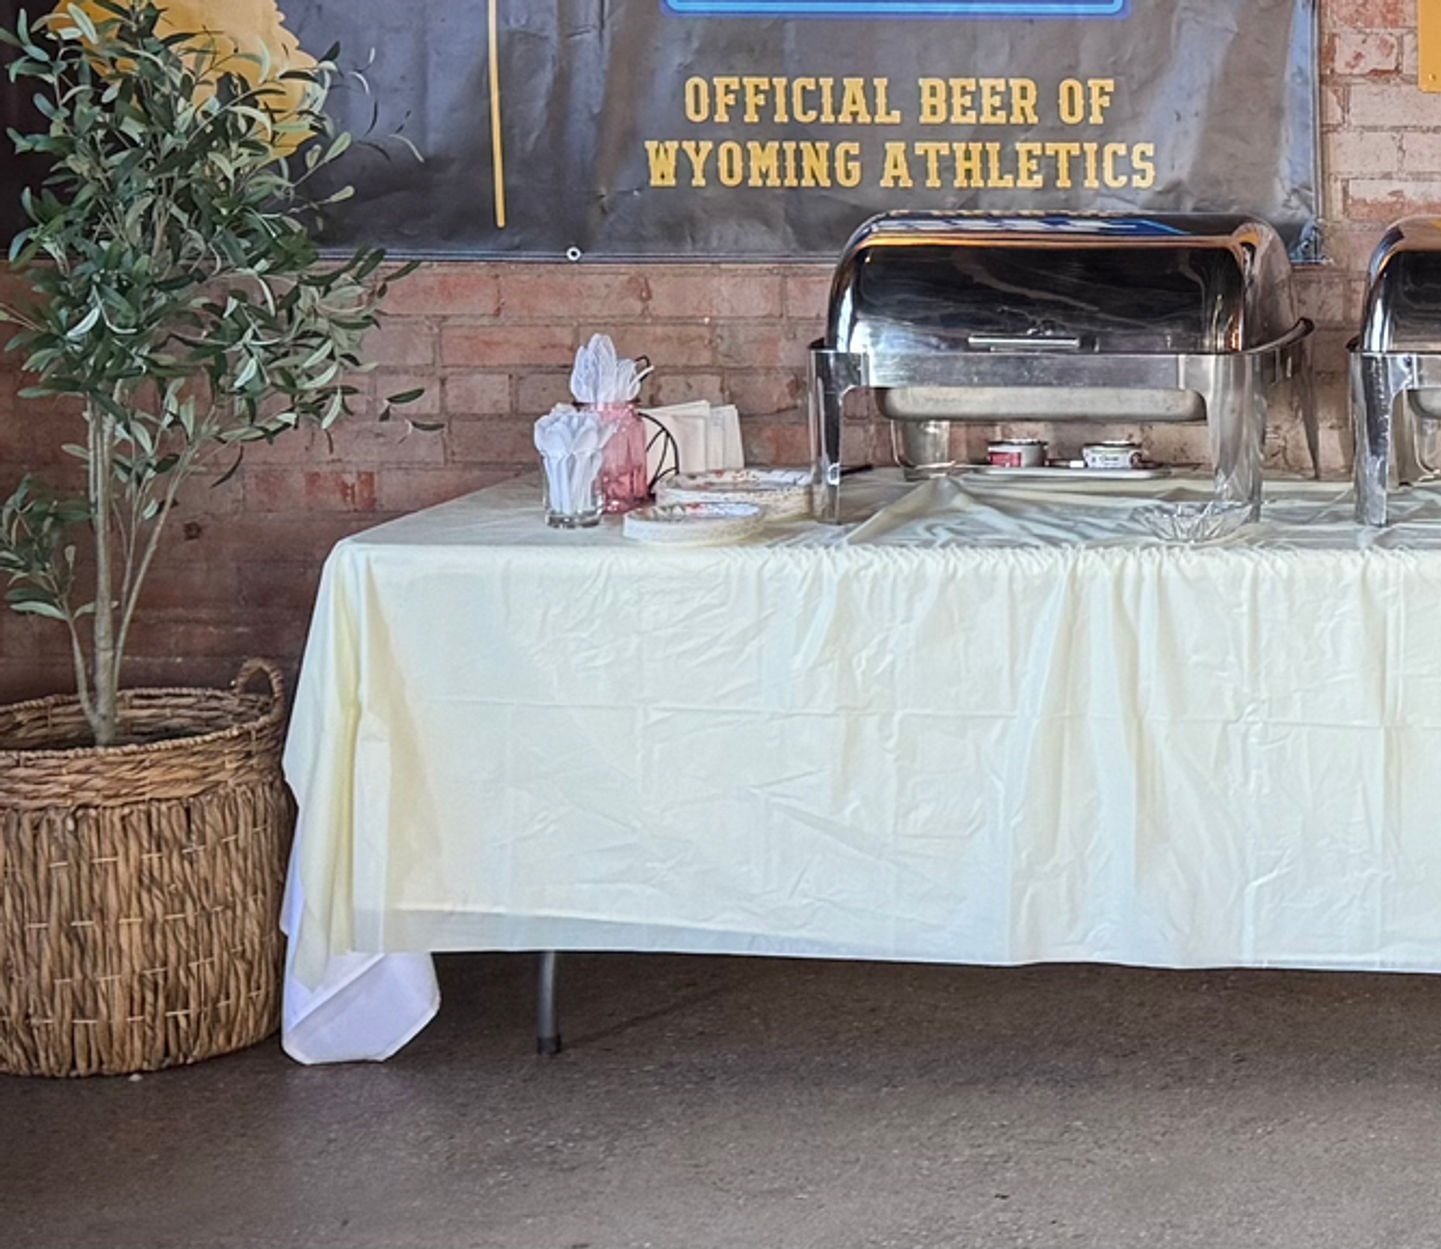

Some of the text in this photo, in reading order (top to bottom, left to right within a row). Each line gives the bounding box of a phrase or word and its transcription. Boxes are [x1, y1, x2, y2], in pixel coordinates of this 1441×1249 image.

[684, 76, 1115, 125] OFFICIAL BEER OF
[644, 140, 1157, 190] WYOMING ATHLETICS
